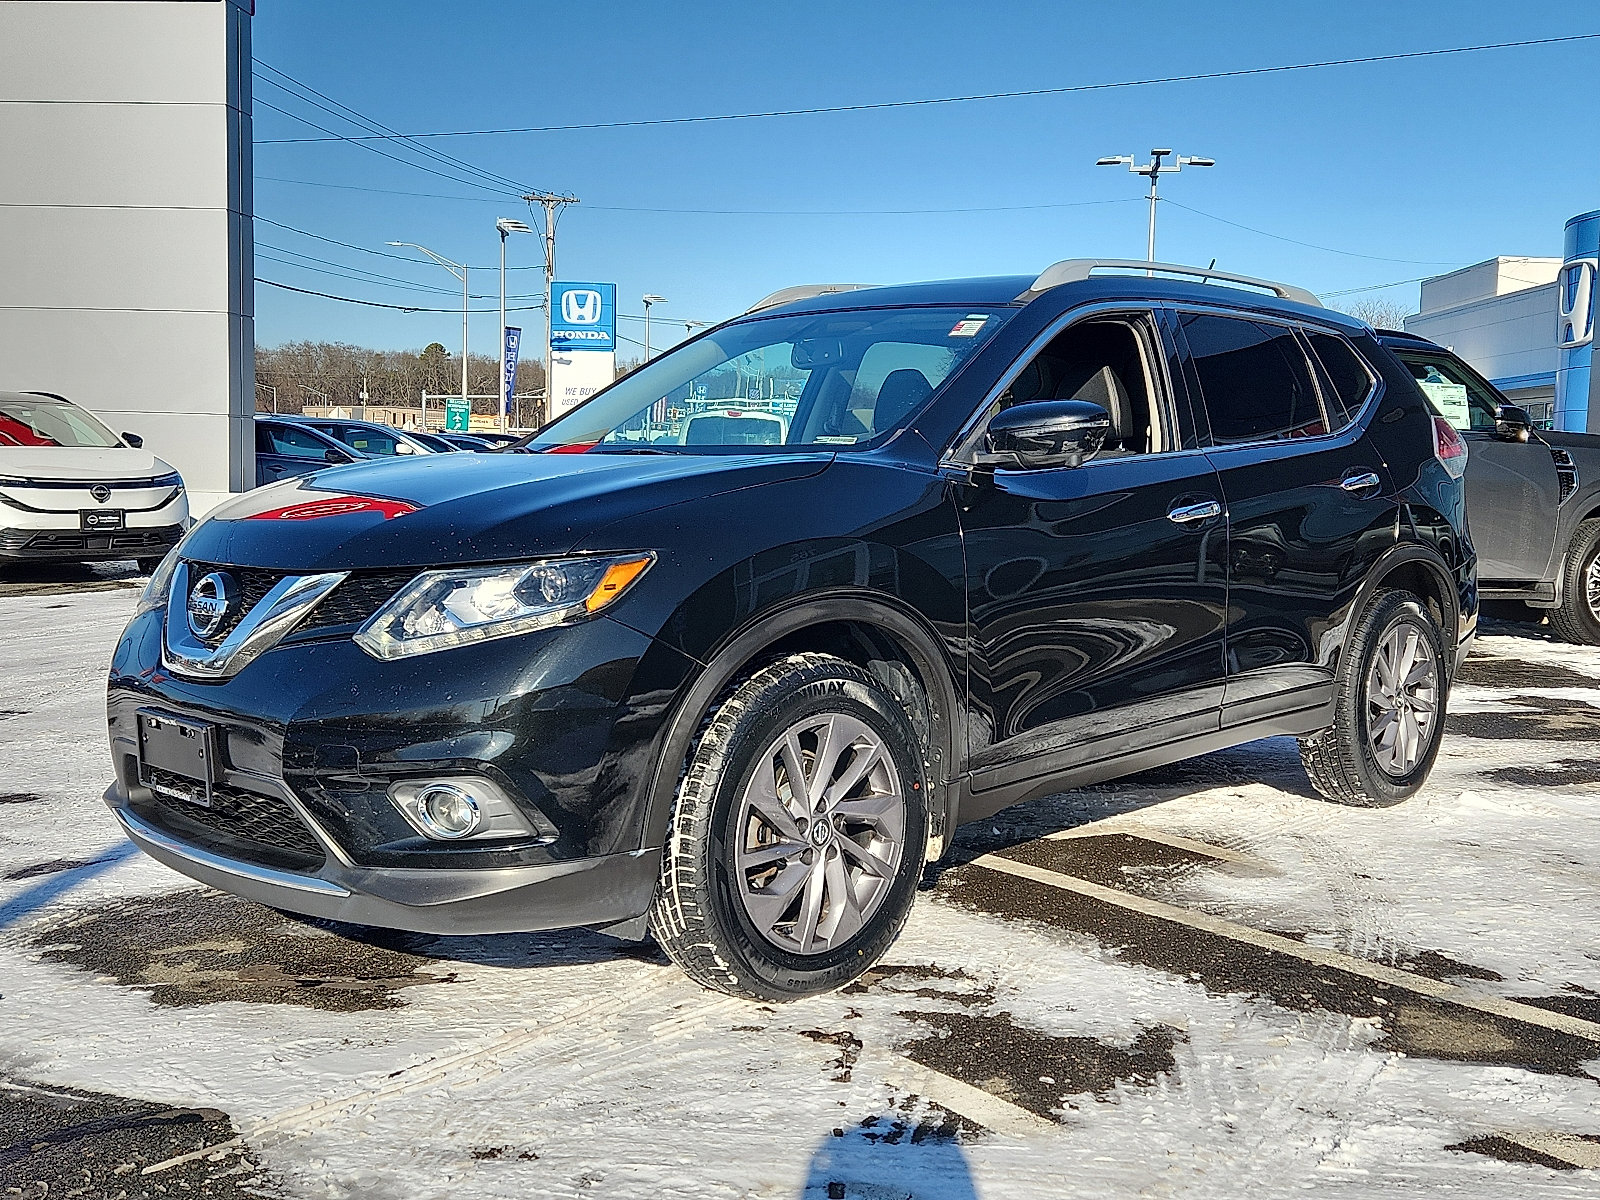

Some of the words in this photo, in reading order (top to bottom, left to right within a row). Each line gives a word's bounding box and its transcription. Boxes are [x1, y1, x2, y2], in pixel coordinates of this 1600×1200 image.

[553, 330, 611, 340] HONDA
[565, 387, 577, 396] WE
[580, 387, 597, 396] BUY
